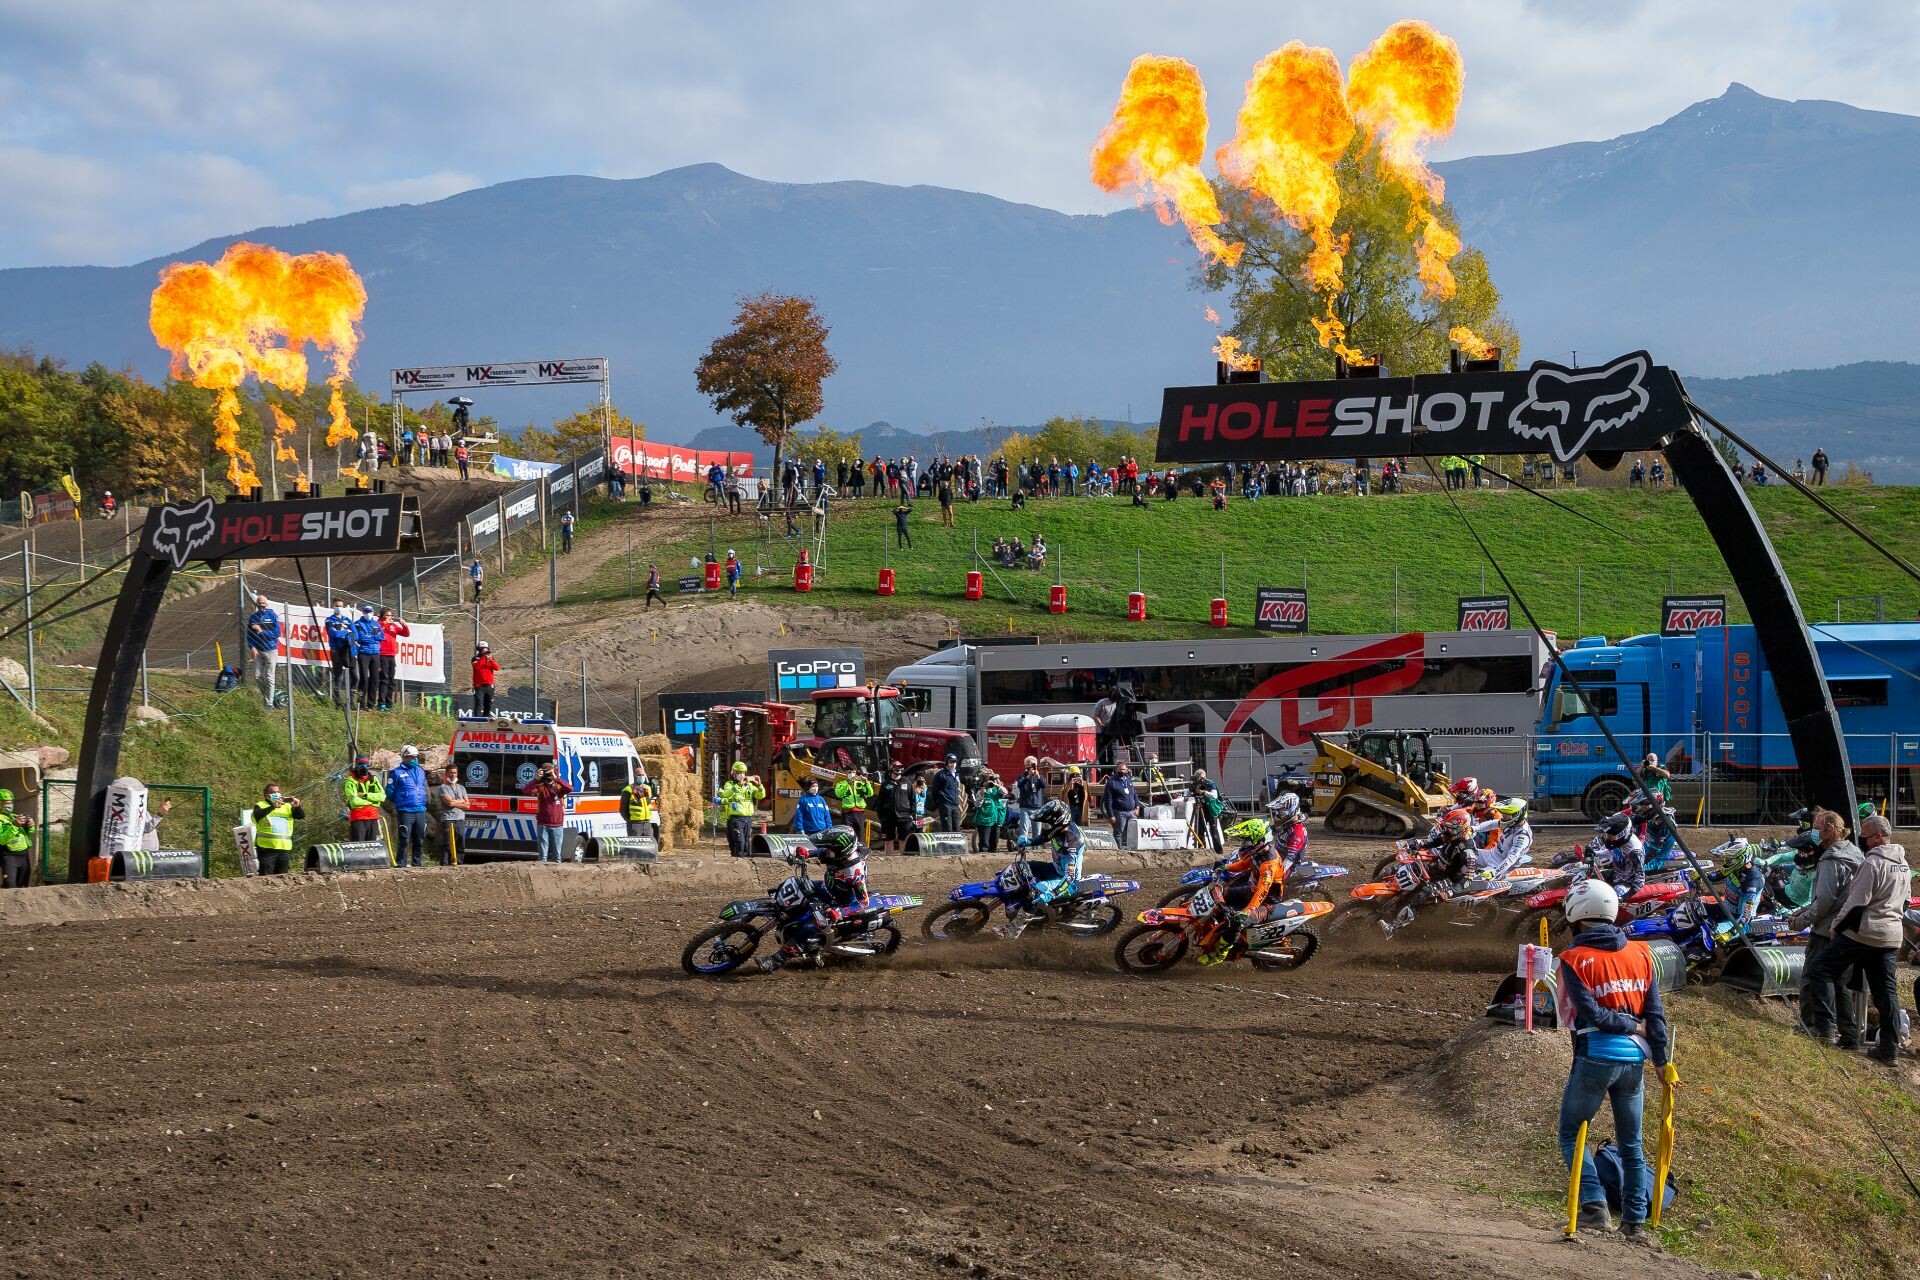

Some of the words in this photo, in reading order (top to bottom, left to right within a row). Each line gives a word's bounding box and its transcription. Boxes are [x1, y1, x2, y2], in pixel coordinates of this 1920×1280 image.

[1178, 391, 1504, 441] HOLESHOT
[221, 508, 389, 544] HOLESHOT
[1259, 601, 1305, 622] KYB
[1461, 609, 1508, 631] KYB
[1666, 609, 1723, 631] KYB
[778, 660, 856, 674] GoPro
[458, 708, 544, 721] MNSTER
[461, 731, 549, 745] AMBULANZA
[1431, 726, 1515, 736] CHAMPIONSHIP
[581, 736, 600, 746] CROCE
[602, 737, 624, 746] BERICA
[1329, 774, 1342, 785] CAT
[1001, 869, 1019, 891] 32
[1635, 902, 1652, 915] 128
[1591, 978, 1648, 999] MARSHAL
